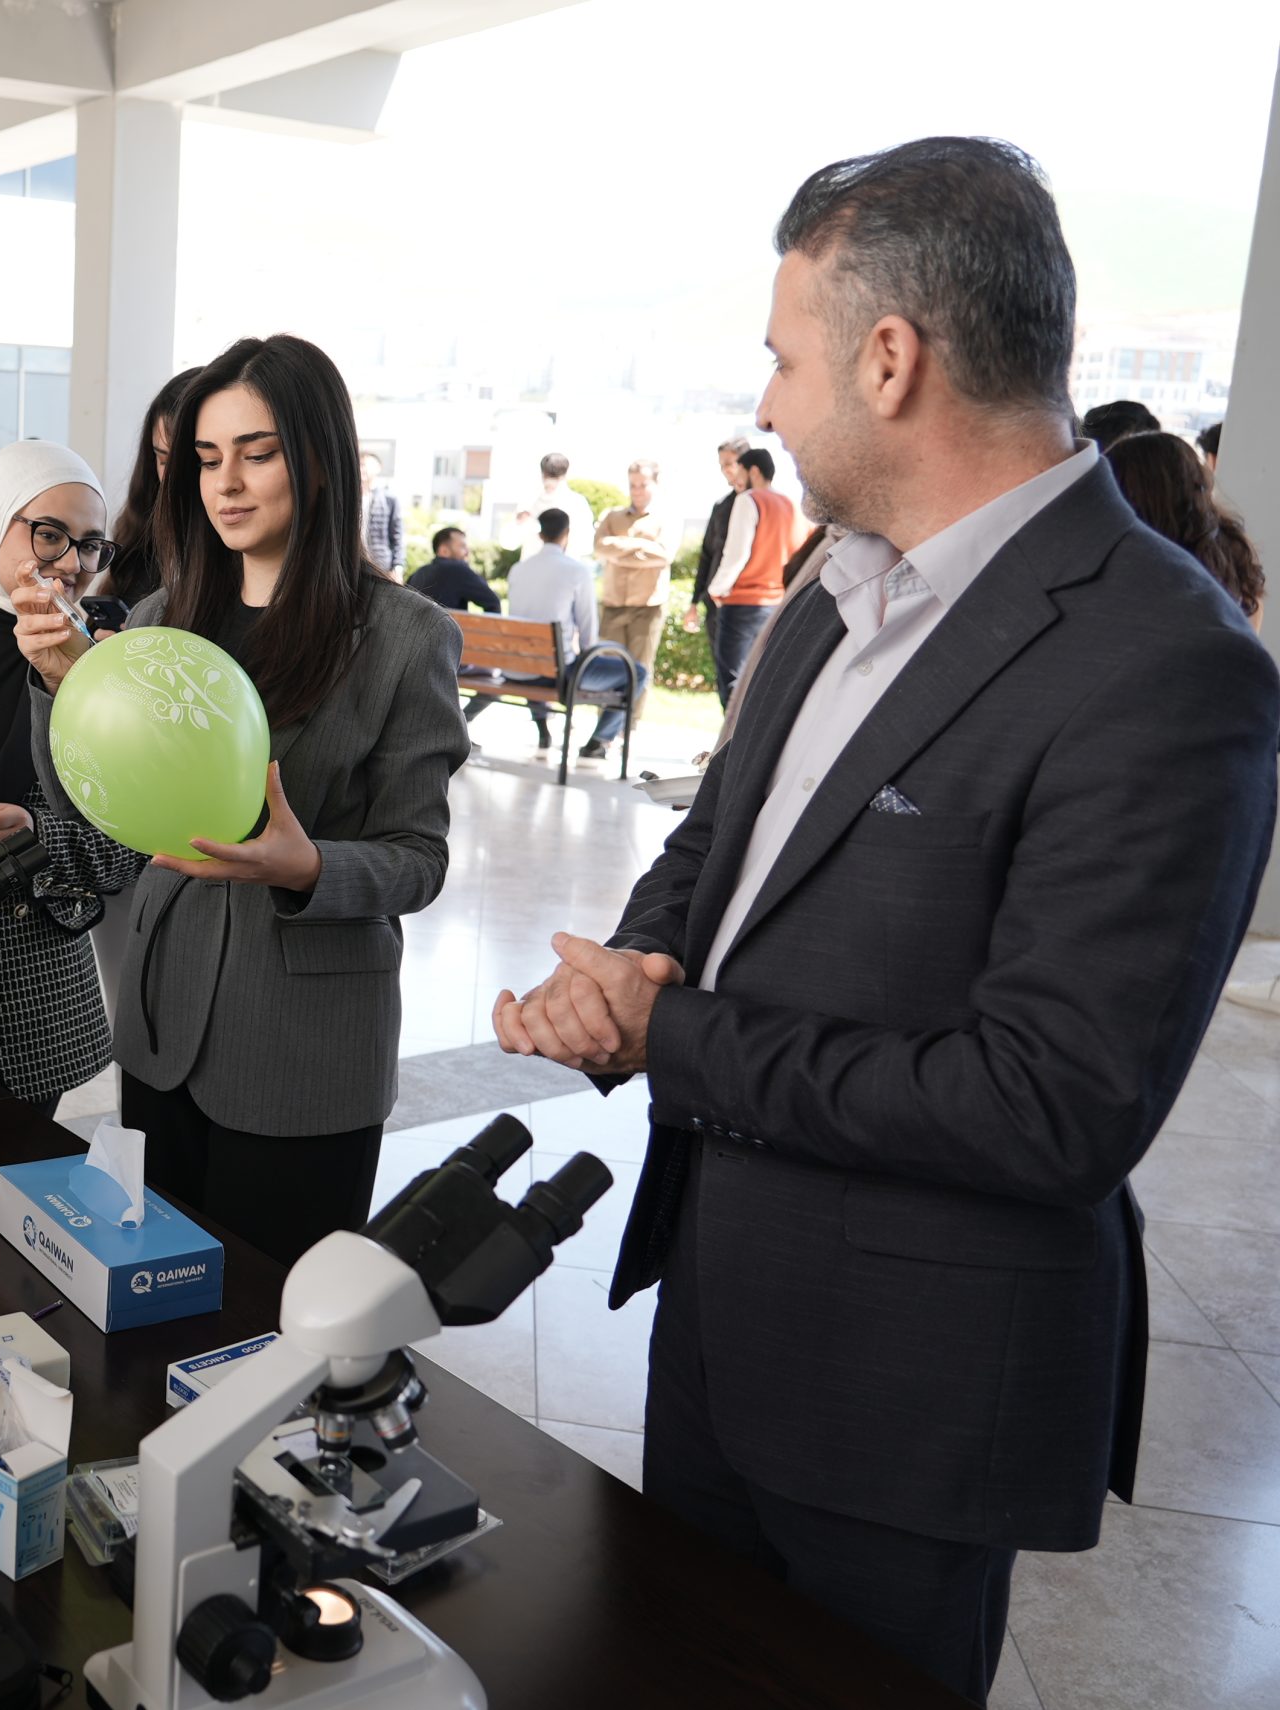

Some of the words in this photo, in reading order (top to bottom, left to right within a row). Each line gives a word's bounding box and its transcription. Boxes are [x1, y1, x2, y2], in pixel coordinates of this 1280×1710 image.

[44, 1194, 75, 1217] QAIWAN
[38, 1231, 74, 1273] QAIWAN
[156, 1263, 206, 1283] QAIWAN
[188, 1353, 231, 1370] LANCETS
